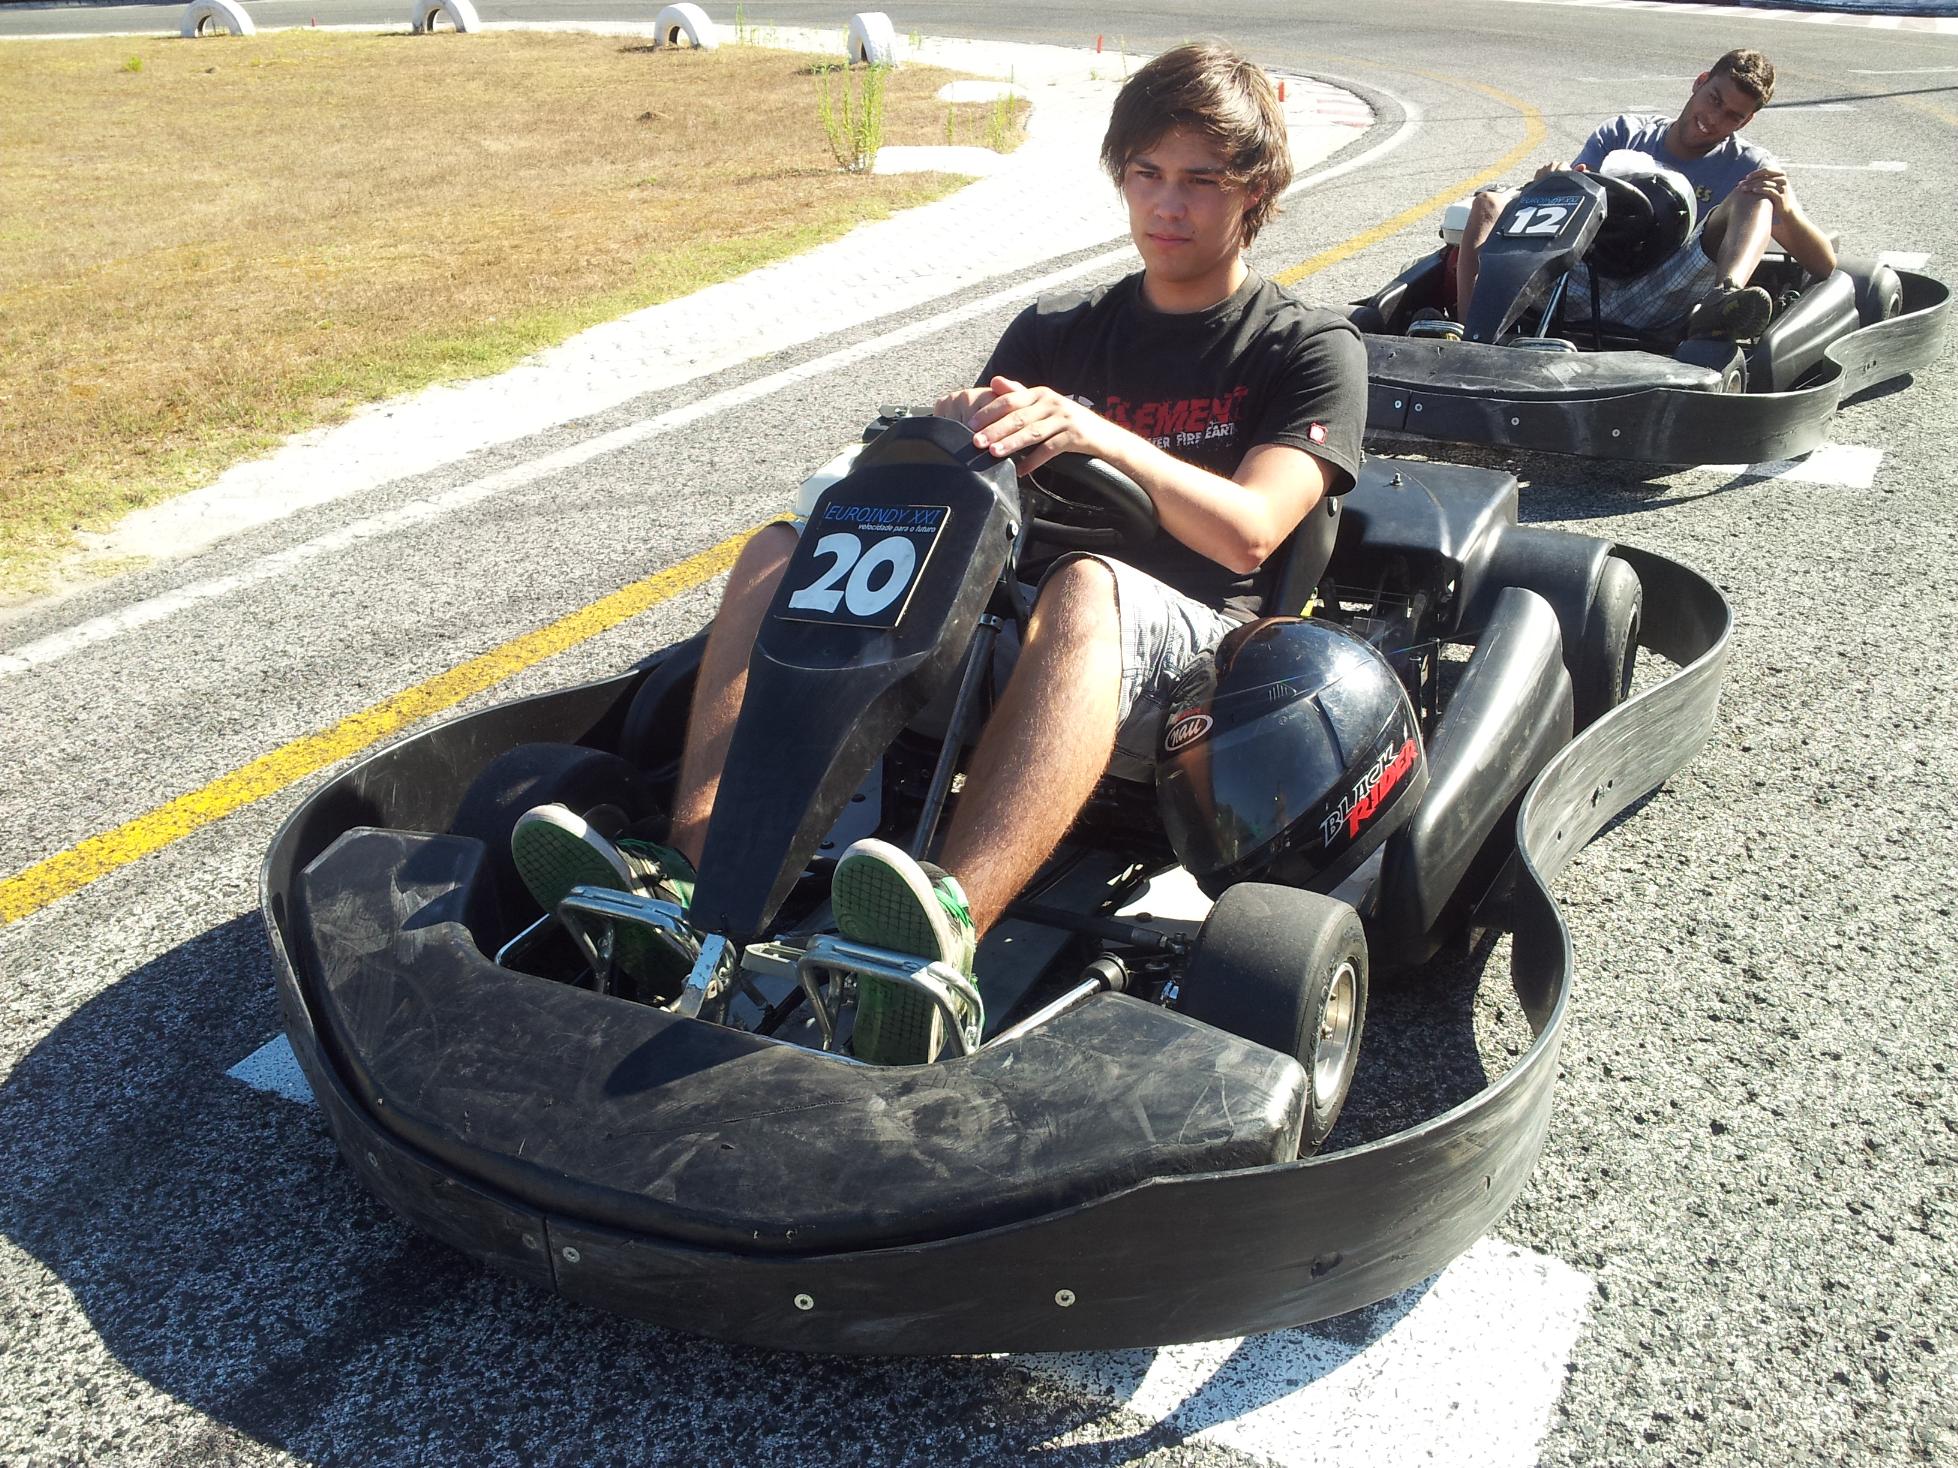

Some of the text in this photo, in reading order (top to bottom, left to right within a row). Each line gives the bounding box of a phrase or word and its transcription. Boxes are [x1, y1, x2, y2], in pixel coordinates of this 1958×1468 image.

[1508, 206, 1568, 234] 12
[825, 505, 942, 525] EUROINDY XXI
[858, 523, 892, 532] velocidade
[892, 525, 909, 533] para
[788, 532, 917, 617] 20
[1319, 741, 1400, 848] BLACK
[1349, 737, 1419, 840] RIDER
